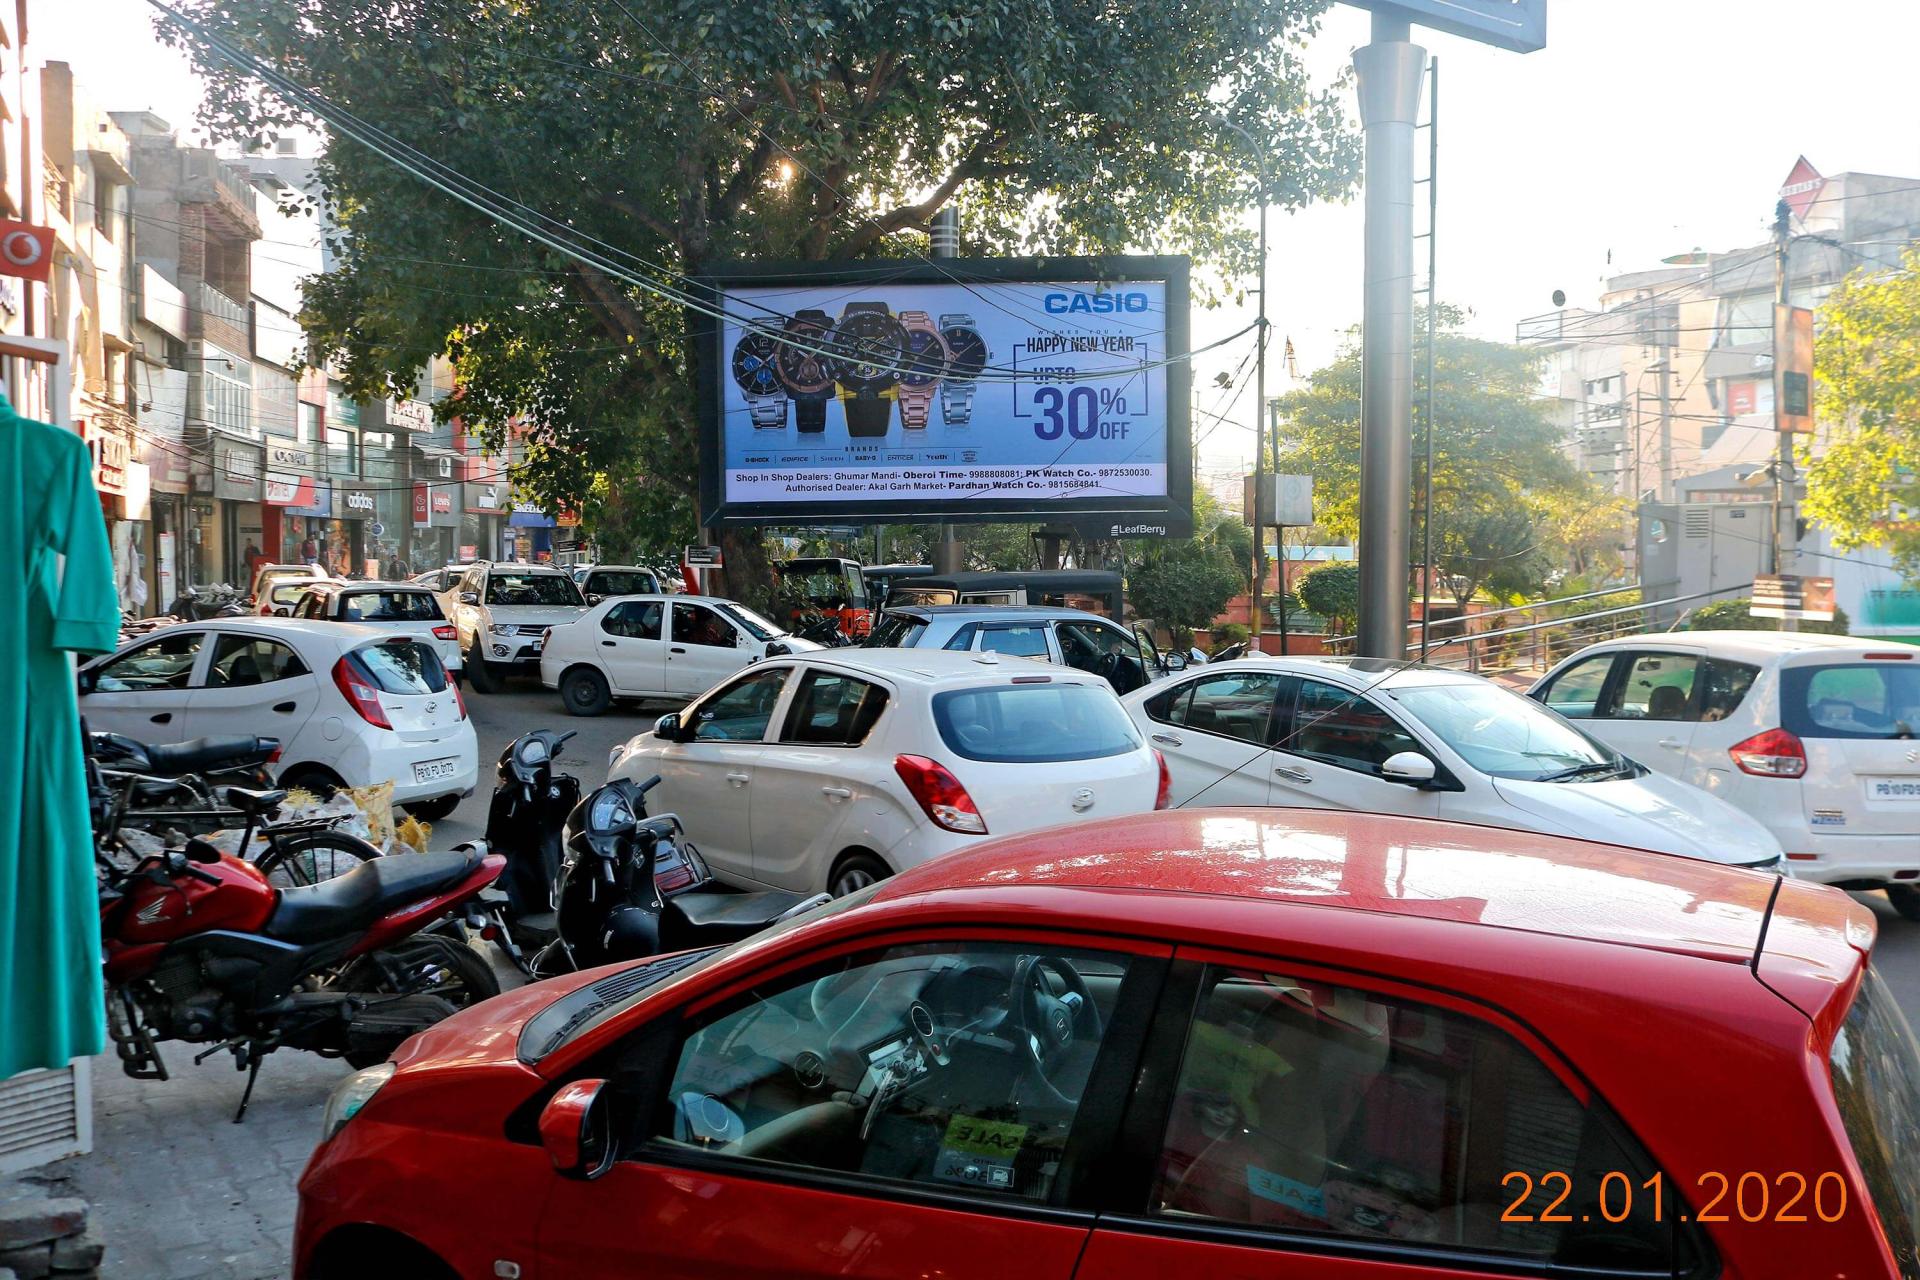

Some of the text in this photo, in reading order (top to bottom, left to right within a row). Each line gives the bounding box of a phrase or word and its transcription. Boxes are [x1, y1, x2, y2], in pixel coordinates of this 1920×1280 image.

[1044, 292, 1148, 314] CASIO
[1027, 336, 1134, 353] HAPPY NEW YEAR
[1100, 421, 1130, 440] OFF
[736, 473, 759, 483] Shop
[760, 473, 769, 482] In
[771, 472, 794, 482] Shop
[796, 472, 832, 481] Dealers:
[834, 471, 869, 482] Ghumar
[871, 471, 901, 480] Mandi-
[903, 470, 936, 479] Oberoi
[939, 470, 967, 479] Time-
[1025, 469, 1040, 478] PK
[1042, 469, 1075, 478] Watch
[785, 483, 833, 493] Authorised
[835, 483, 866, 492] Dealer:
[868, 482, 888, 491] Akal
[889, 481, 911, 490] Garh
[913, 480, 947, 490] Market-
[948, 480, 990, 490] Pardhan
[992, 480, 1025, 490] Watch
[348, 491, 373, 510] adidas
[1119, 524, 1166, 536] LeafBerry
